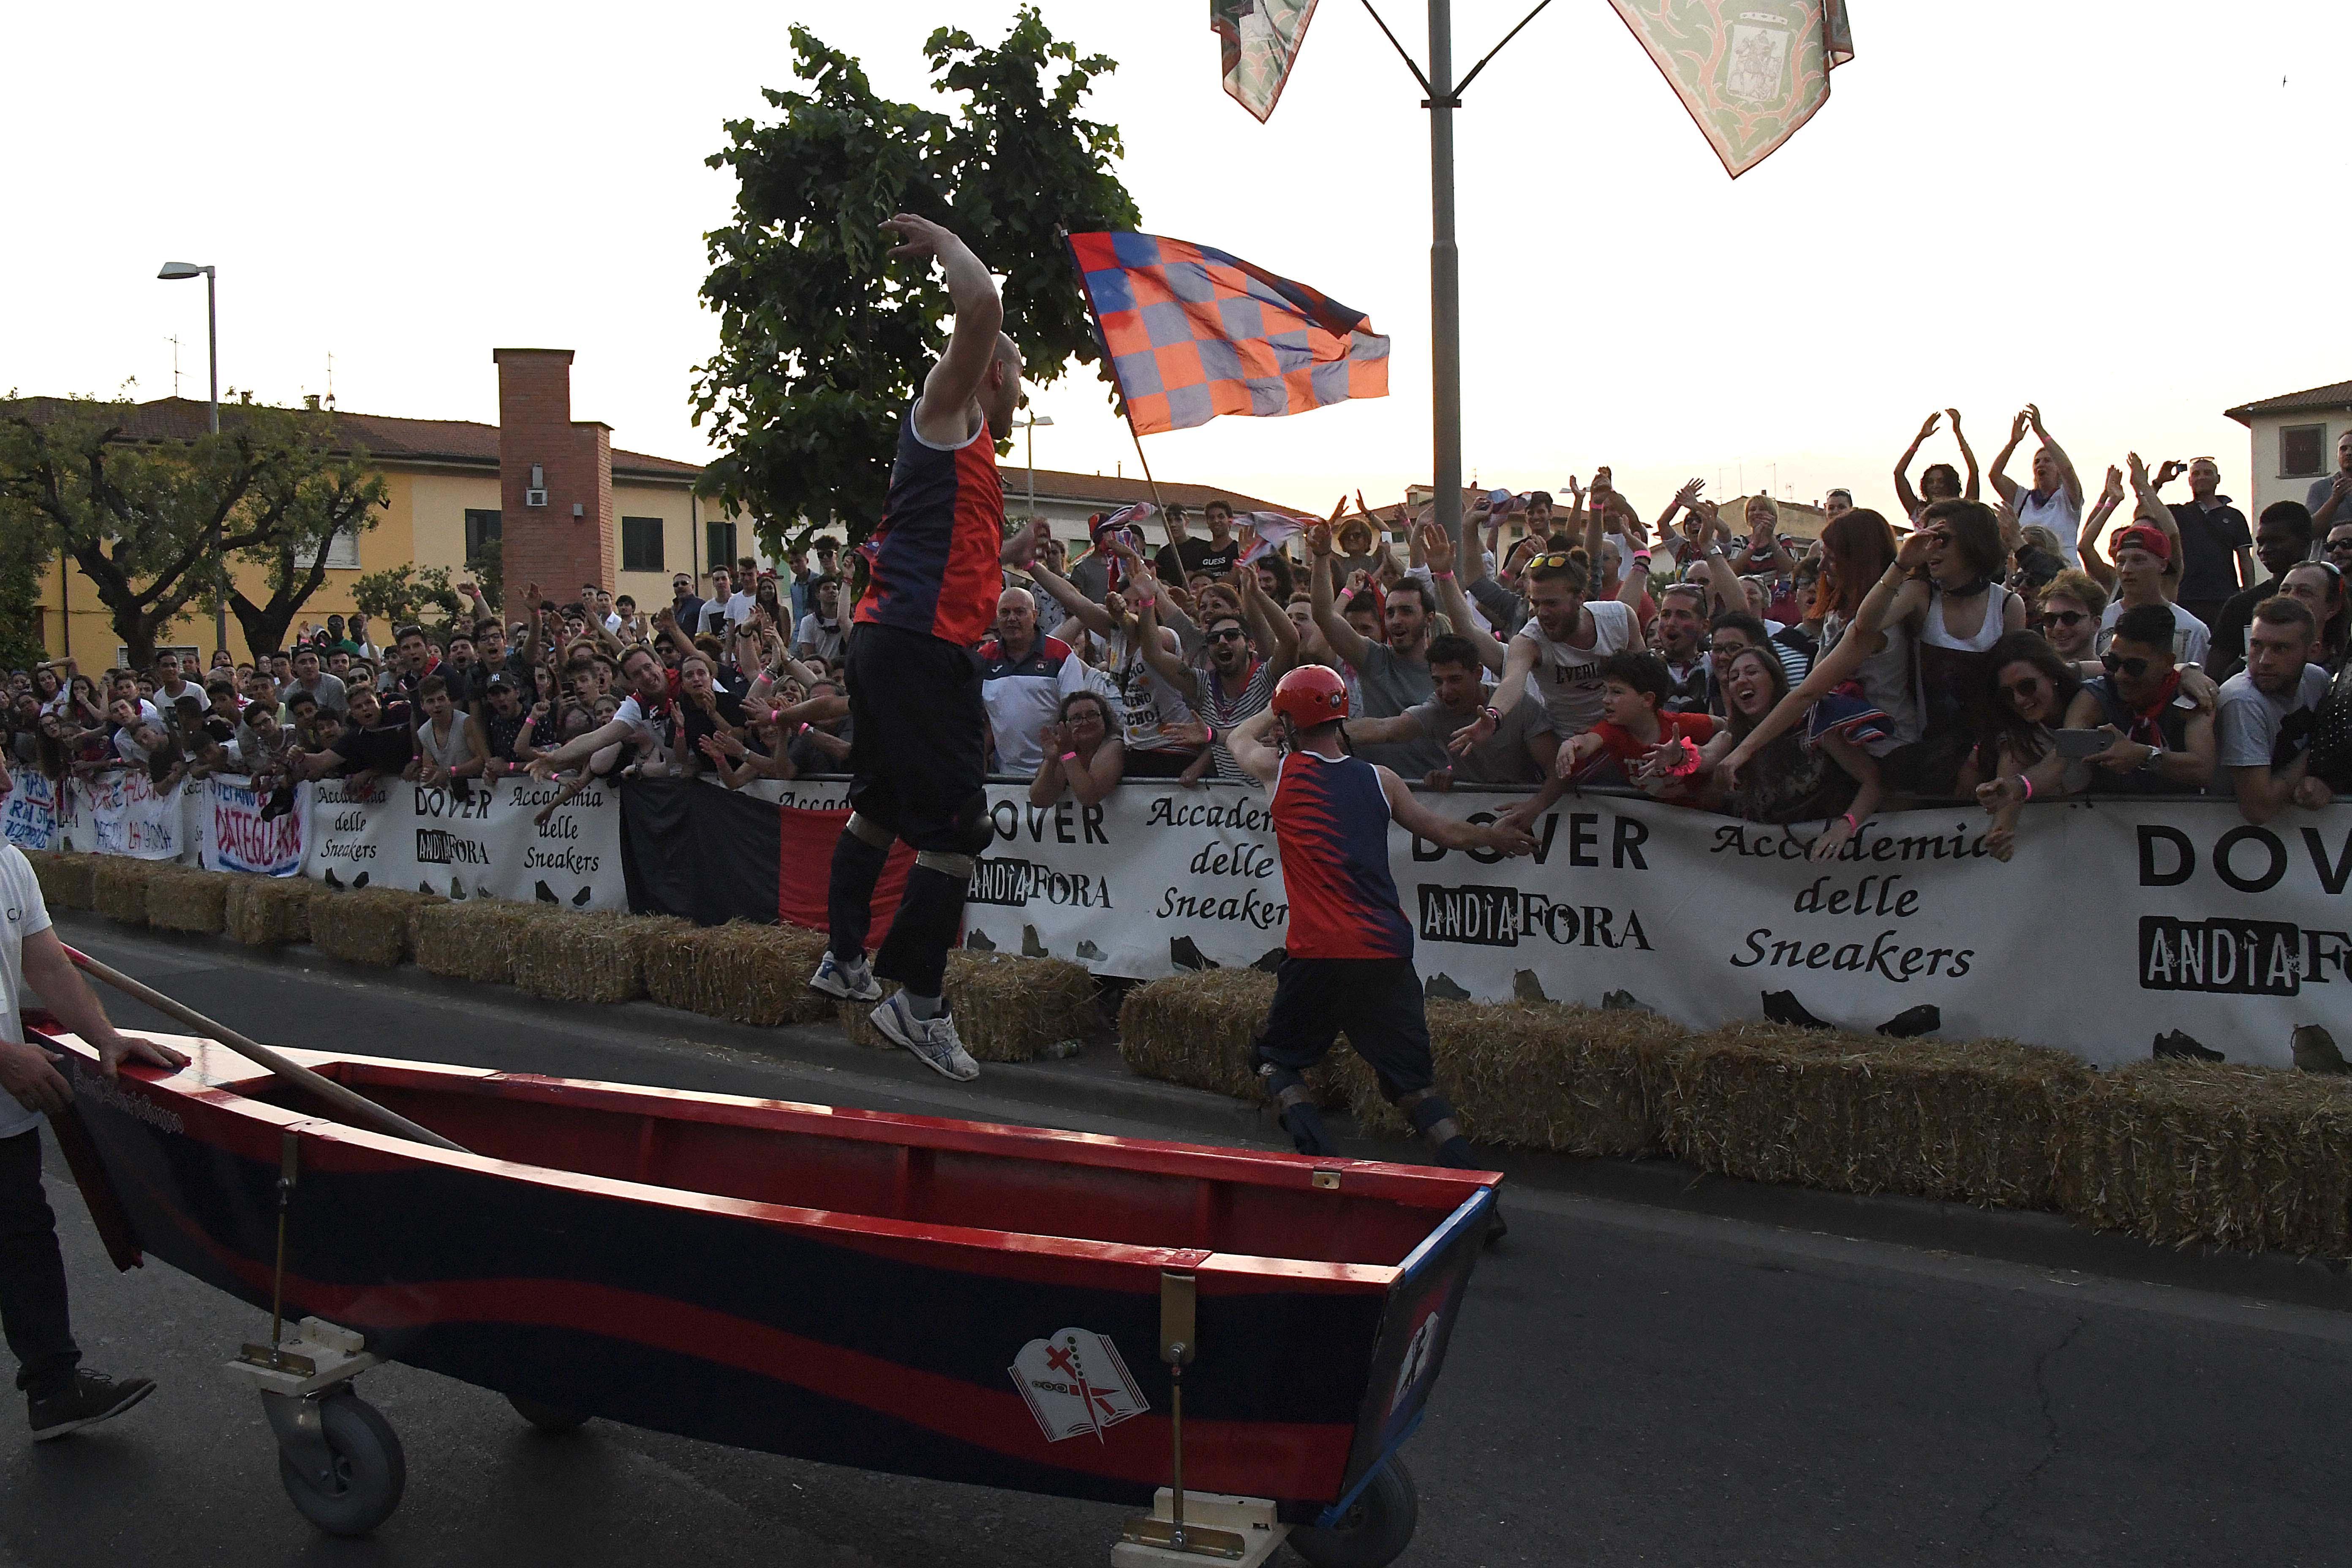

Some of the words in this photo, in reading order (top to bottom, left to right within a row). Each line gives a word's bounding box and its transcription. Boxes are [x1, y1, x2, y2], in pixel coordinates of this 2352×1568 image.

[1203, 557, 1225, 565] GUESS
[415, 787, 492, 819] DOVER
[335, 811, 366, 831] delle
[990, 799, 1109, 844] OVER
[321, 838, 377, 862] Sneakers
[524, 846, 599, 874] Sneakers
[1190, 841, 1274, 879] delle
[1156, 886, 1289, 930] Sneaker
[1793, 874, 1919, 917] delle
[1729, 928, 1975, 983] Sneakers
